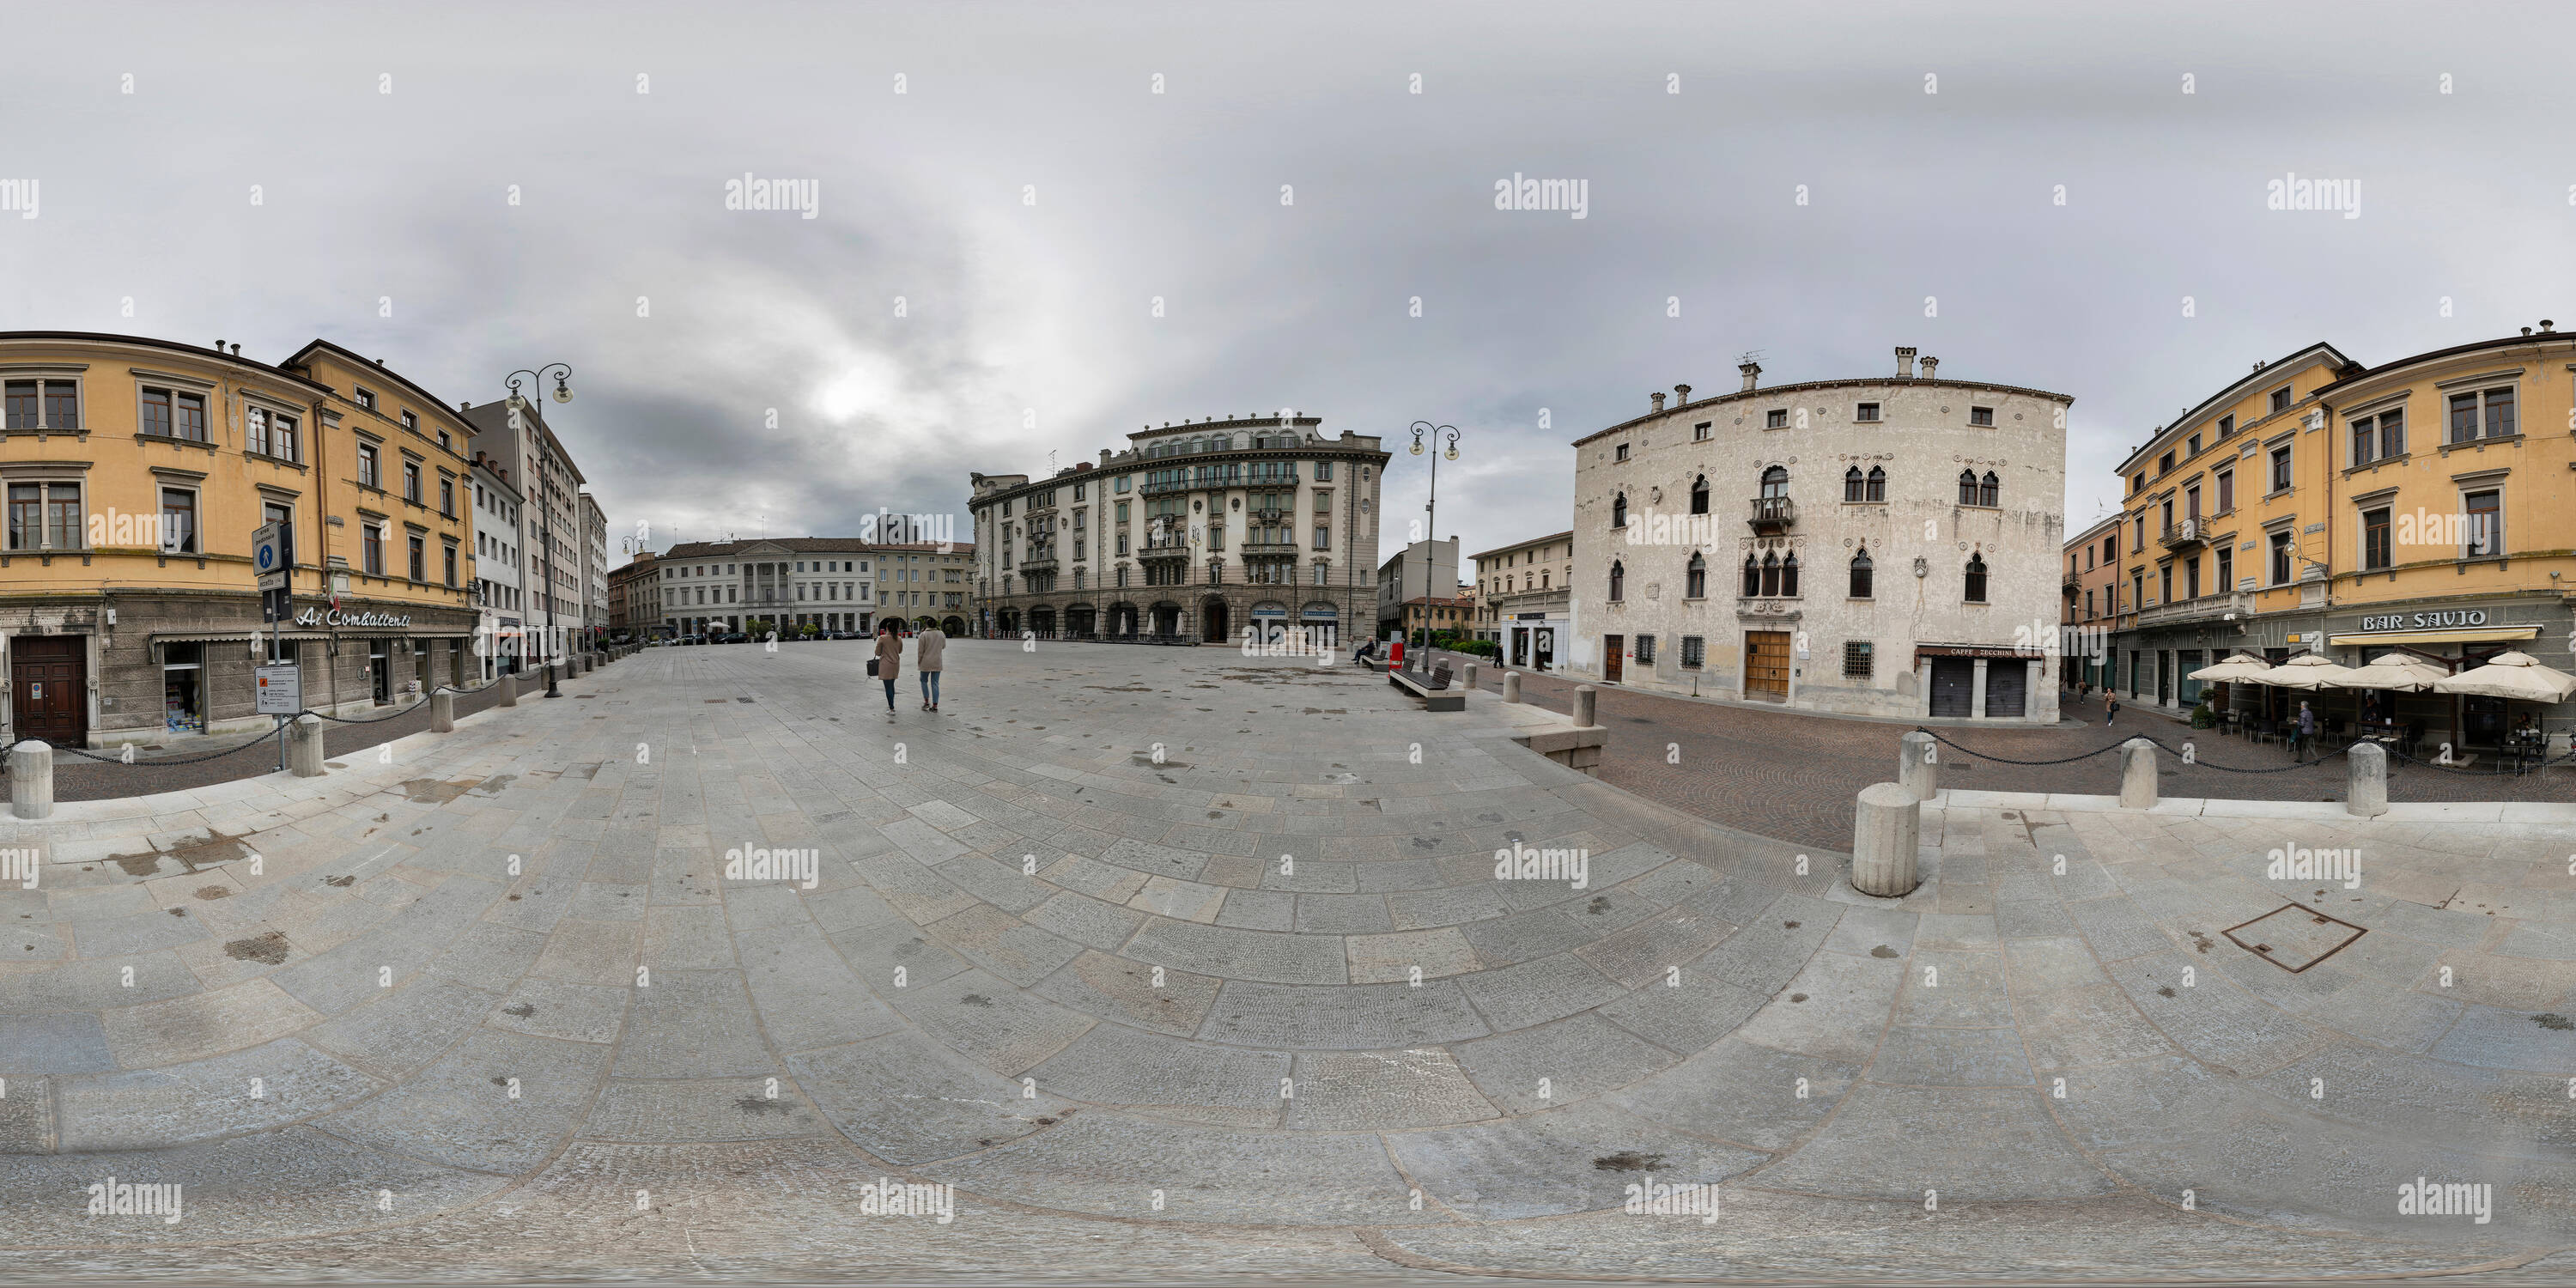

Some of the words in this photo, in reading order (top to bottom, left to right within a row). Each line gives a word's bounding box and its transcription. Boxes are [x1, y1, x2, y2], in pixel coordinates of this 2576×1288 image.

[255, 532, 275, 545] pedonale
[259, 579, 274, 587] eccetto
[295, 606, 323, 626] Ai
[326, 608, 411, 627] Combattenti
[2363, 615, 2403, 630] BAR
